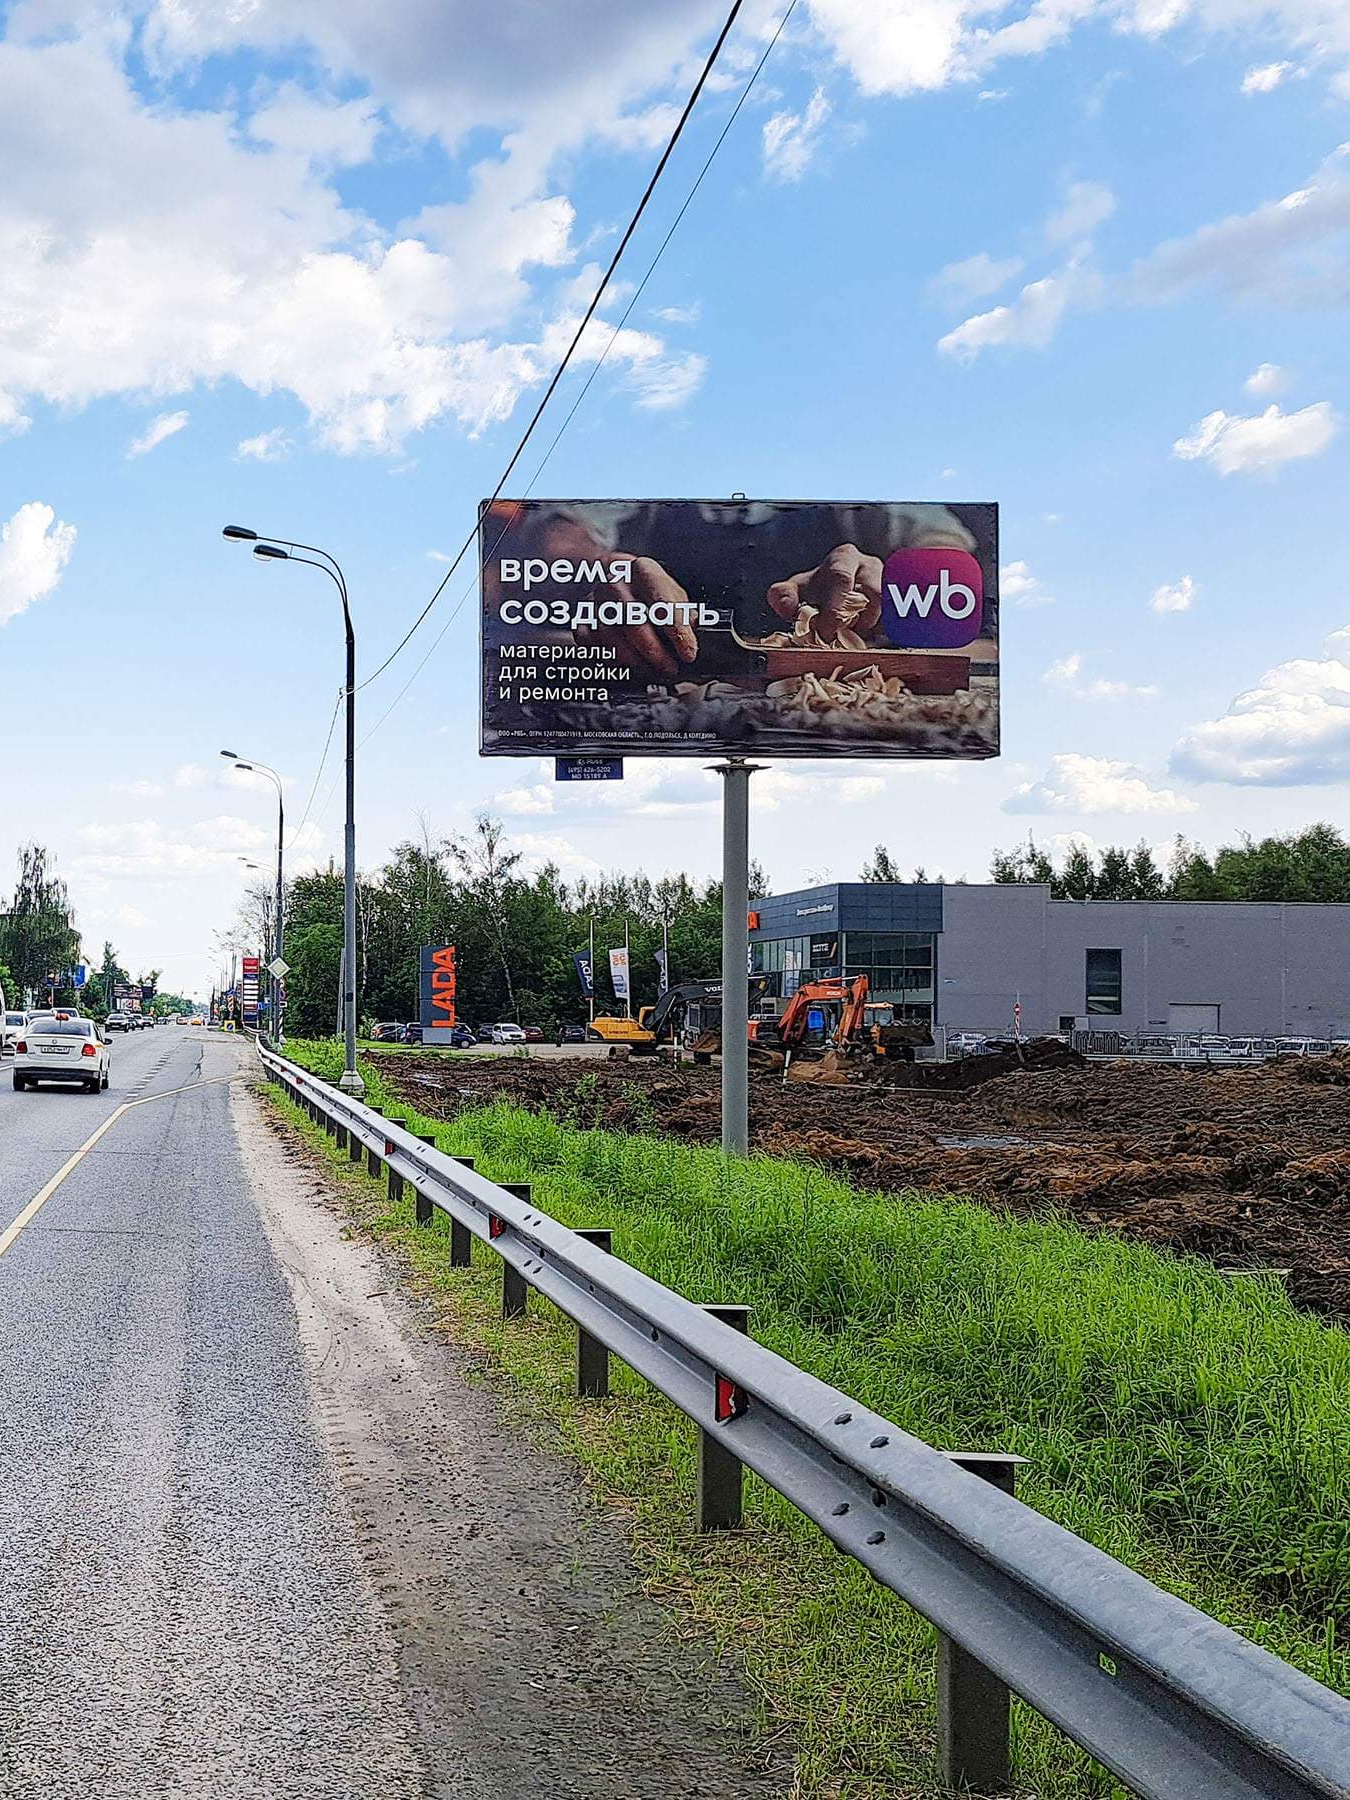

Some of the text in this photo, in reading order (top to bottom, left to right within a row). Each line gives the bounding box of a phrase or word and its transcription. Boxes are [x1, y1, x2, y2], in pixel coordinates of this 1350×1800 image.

[500, 558, 632, 591] время
[887, 569, 976, 620] wb
[499, 600, 720, 629] создавать
[500, 645, 616, 662] материалы
[499, 663, 630, 683] для стройки
[499, 687, 608, 703] и ремонта
[432, 945, 456, 1027] LADA
[704, 985, 723, 993] VOL
